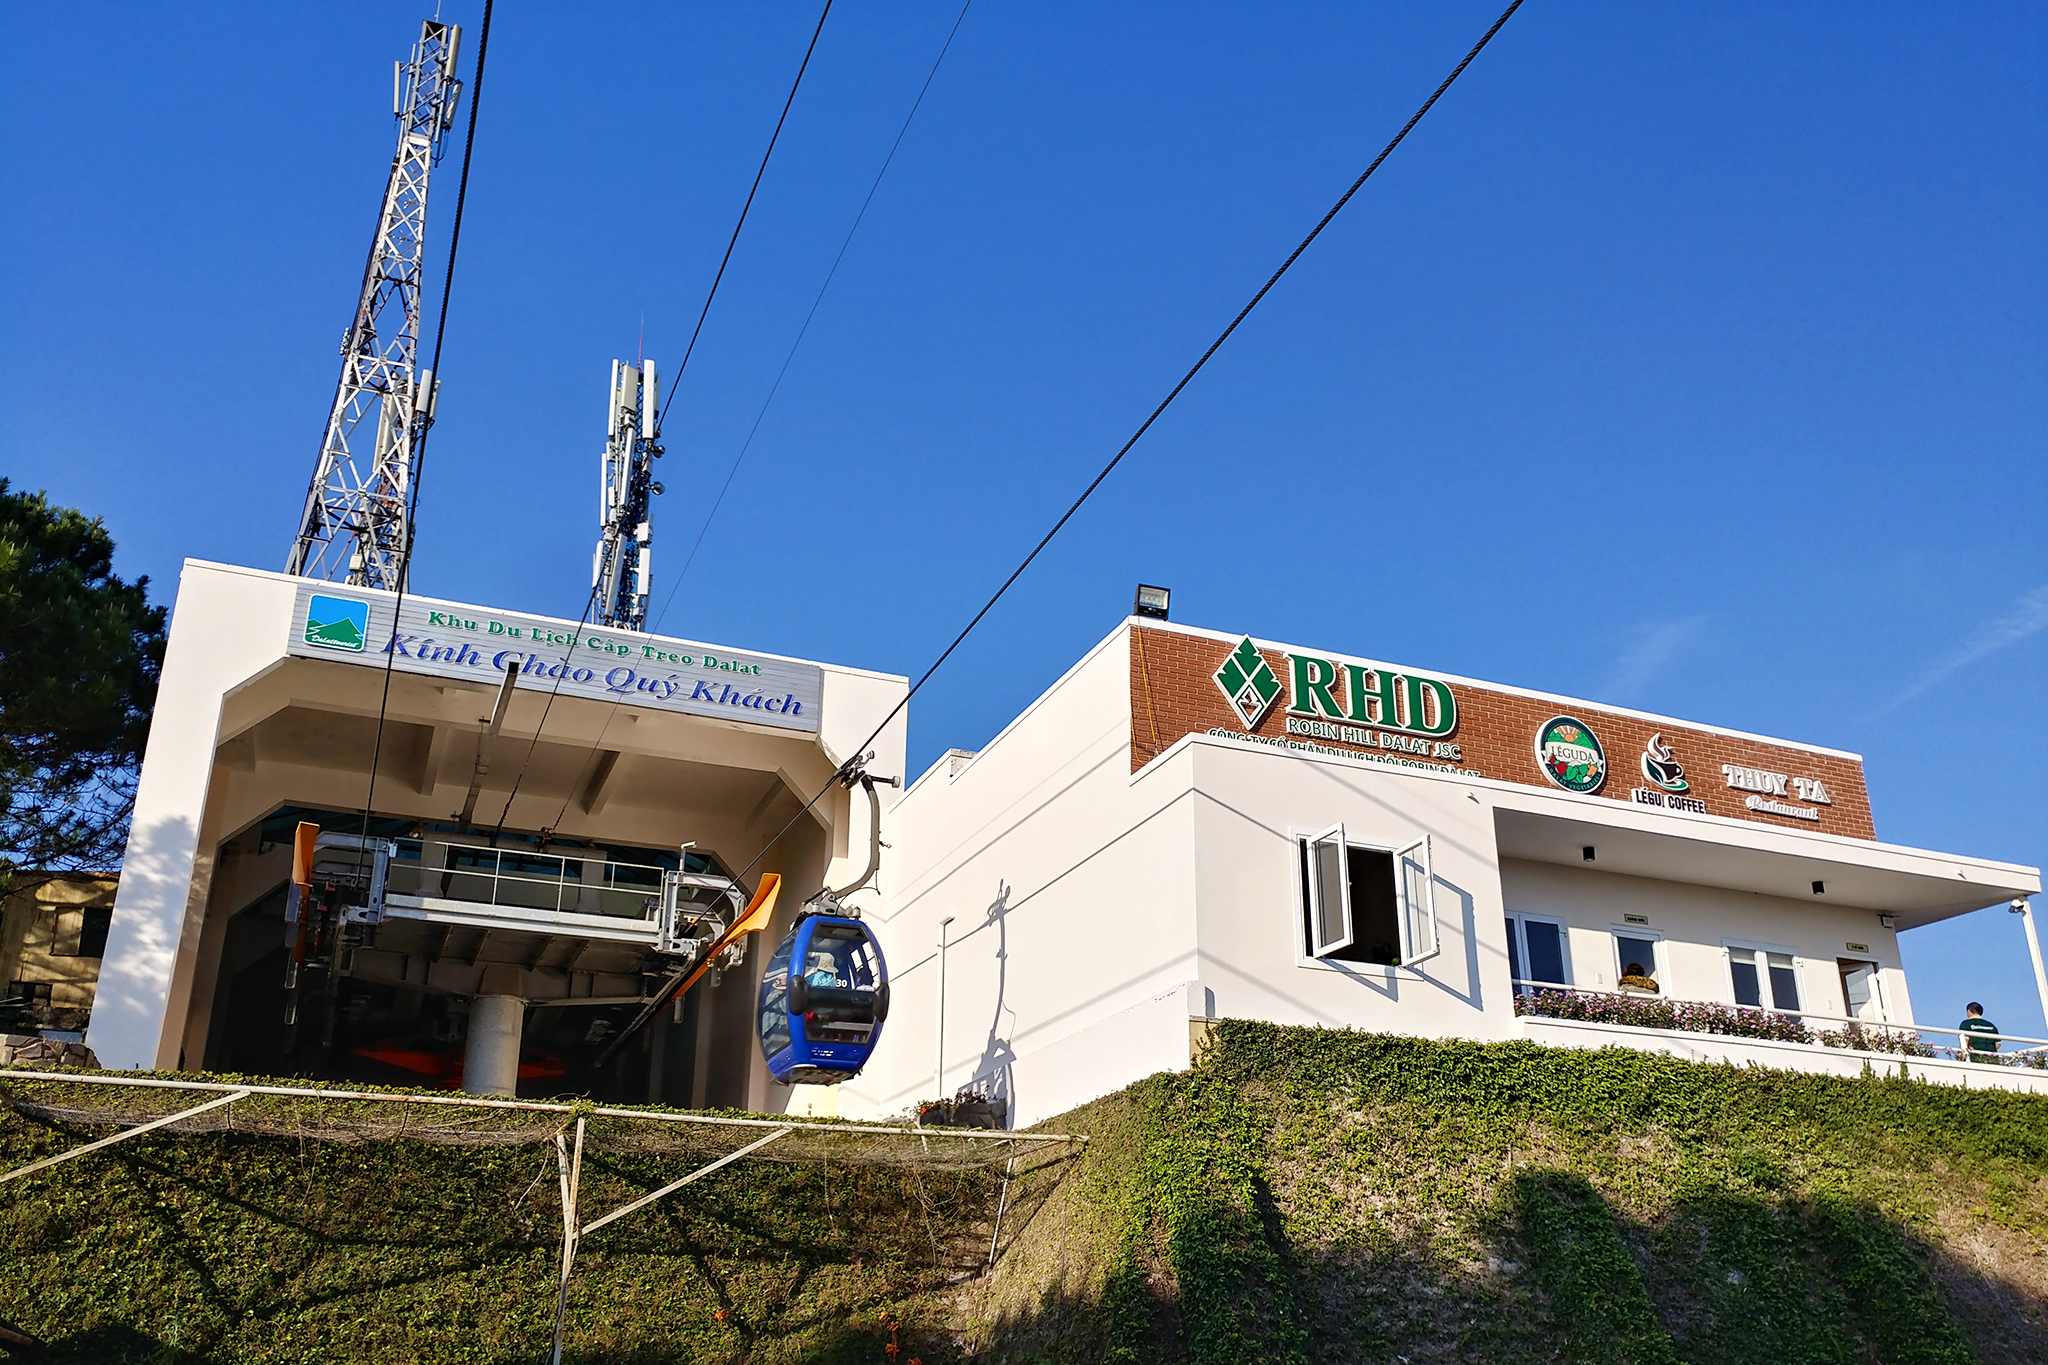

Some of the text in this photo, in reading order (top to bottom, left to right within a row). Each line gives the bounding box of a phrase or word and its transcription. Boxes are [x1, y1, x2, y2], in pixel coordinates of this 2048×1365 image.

[429, 611, 762, 675] Khu Du Lịch Cáp Treo Dalat
[381, 633, 803, 716] Kính Chào Quý Khách
[1285, 653, 1456, 737] RHD
[1289, 718, 1461, 760] ROBIN HILL DALAT JSC
[1551, 745, 1594, 763] LÉGUDA
[1635, 787, 1705, 814] LÉGU COFFEE
[1725, 765, 1831, 803] THUY TA
[1748, 795, 1819, 820] Restaurant
[836, 979, 847, 988] 30
